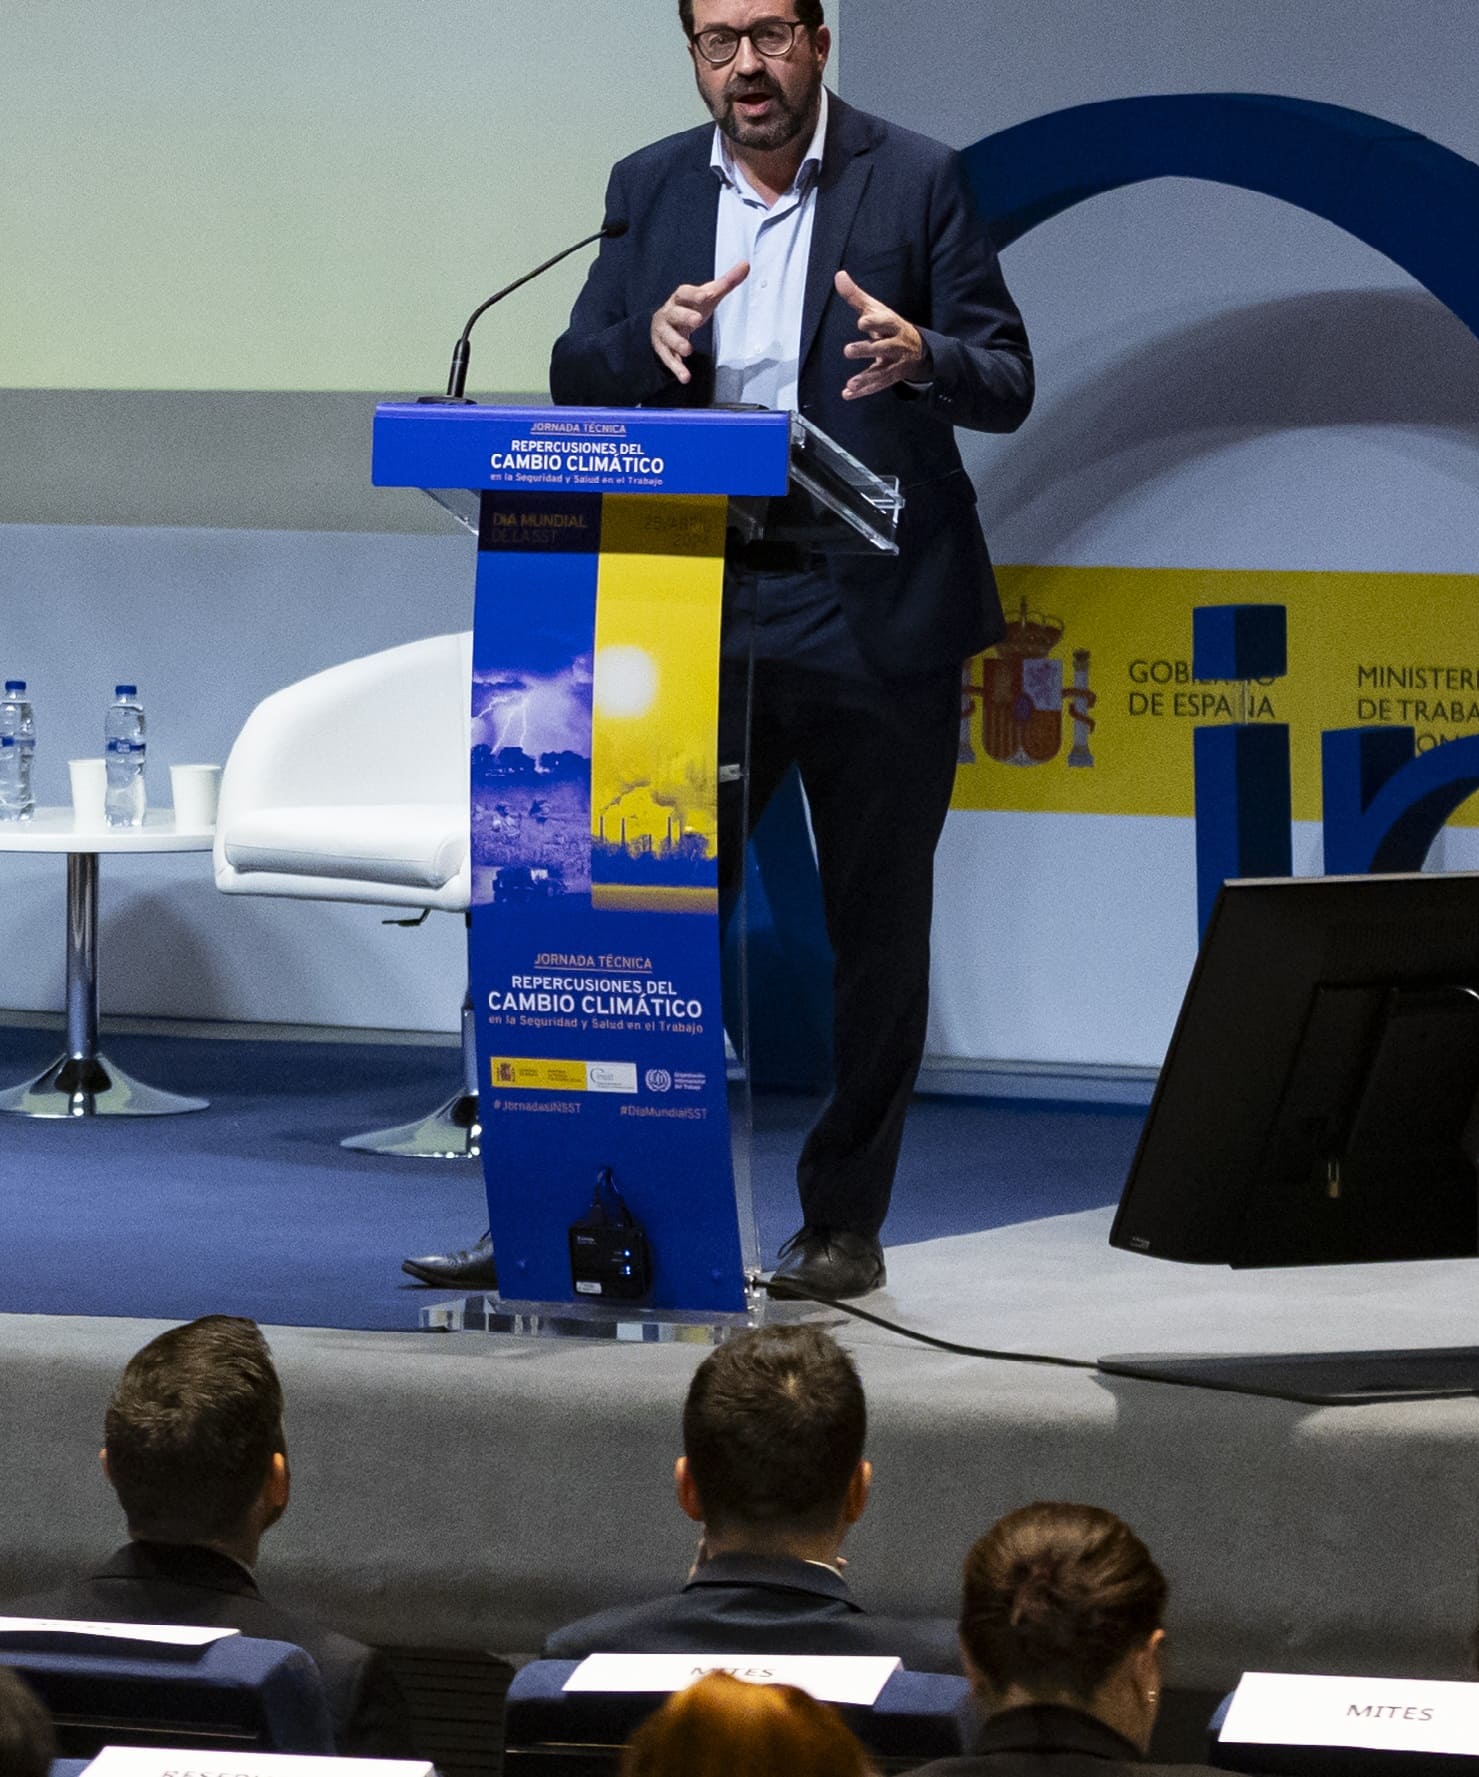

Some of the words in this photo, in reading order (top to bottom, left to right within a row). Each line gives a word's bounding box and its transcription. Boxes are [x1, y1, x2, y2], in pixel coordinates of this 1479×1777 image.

[530, 423, 581, 433] JORNADA
[511, 440, 616, 455] REPERCUSIONES
[619, 443, 645, 455] DEL
[490, 453, 562, 471] CAMBIO
[566, 454, 665, 474] CLIMÁTICO
[490, 473, 502, 481] en
[504, 473, 513, 481] la
[515, 473, 563, 484] Seguridad
[565, 476, 571, 484] y
[573, 475, 600, 484] Salud
[601, 476, 614, 485] en
[616, 476, 625, 485] el
[628, 476, 664, 486] Trabajo
[1128, 692, 1165, 717] DE
[1357, 699, 1392, 721] DE
[534, 953, 596, 968] JORNADA
[598, 954, 653, 969] TÉCNICA
[511, 975, 642, 993] REPERCUSIONES
[646, 980, 678, 995] DEL
[488, 991, 575, 1013] CAMBIO
[581, 993, 703, 1018] CLIMÁTICO
[488, 1015, 502, 1024] en
[505, 1014, 516, 1025] la
[519, 1015, 578, 1028] Seguridad
[580, 1019, 588, 1031] y
[592, 1017, 624, 1030] Salud
[627, 1021, 642, 1031] en
[644, 1020, 656, 1031] el
[659, 1021, 704, 1035] Trabajo
[689, 1667, 776, 1678] MTES
[1345, 1703, 1435, 1722] MITES
